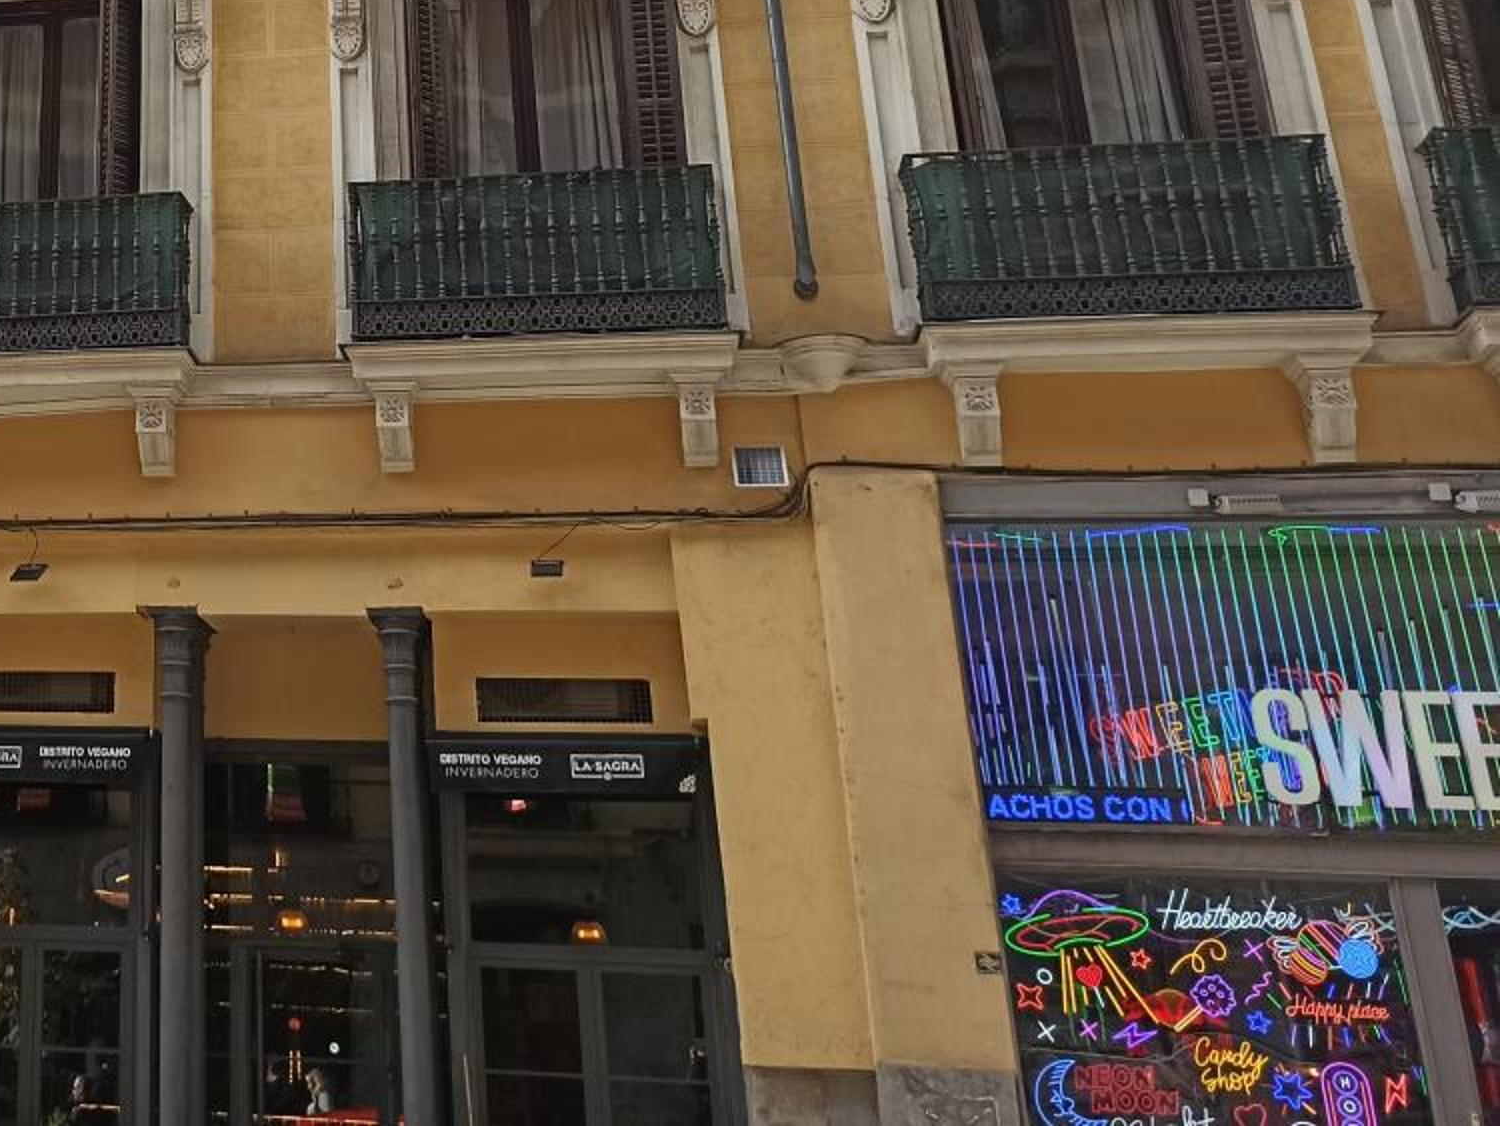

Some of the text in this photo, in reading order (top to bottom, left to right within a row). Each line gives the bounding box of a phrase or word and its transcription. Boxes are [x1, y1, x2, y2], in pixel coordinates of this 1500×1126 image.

[39, 746, 131, 757] DISTRITO VEGANO
[439, 753, 542, 765] DISTRITO VEGANO
[43, 759, 128, 770] INVERNADERO
[445, 767, 539, 779] INVERNADERO
[988, 793, 1096, 820] ACHOS
[1104, 795, 1173, 822] CON
[1156, 888, 1303, 930] Heartbreaker
[1285, 994, 1345, 1023] Happy
[1194, 1035, 1268, 1080] Candy
[1074, 1064, 1156, 1090] NEON
[1091, 1089, 1179, 1114] MOON
